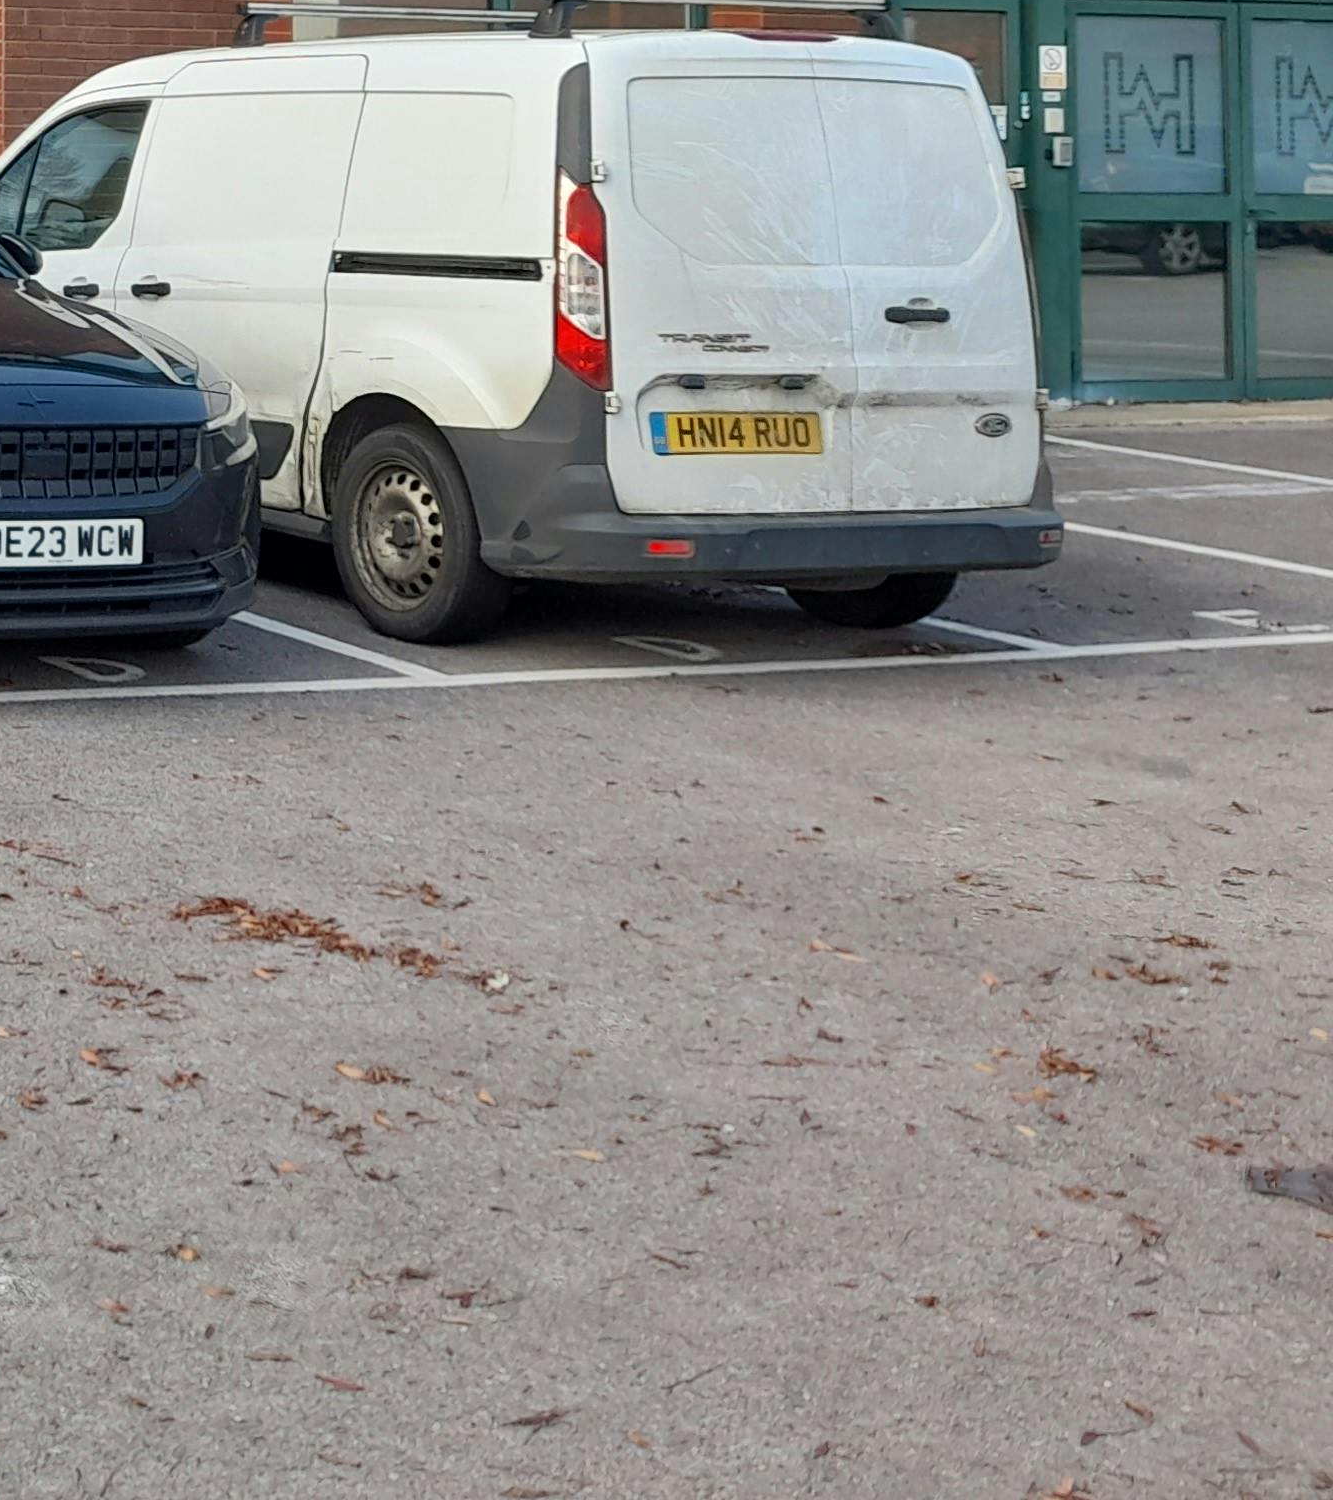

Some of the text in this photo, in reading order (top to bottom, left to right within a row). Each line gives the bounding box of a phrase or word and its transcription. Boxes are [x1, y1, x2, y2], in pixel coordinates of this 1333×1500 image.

[676, 417, 811, 448] HN14 RUO
[77, 525, 134, 557] WCW
